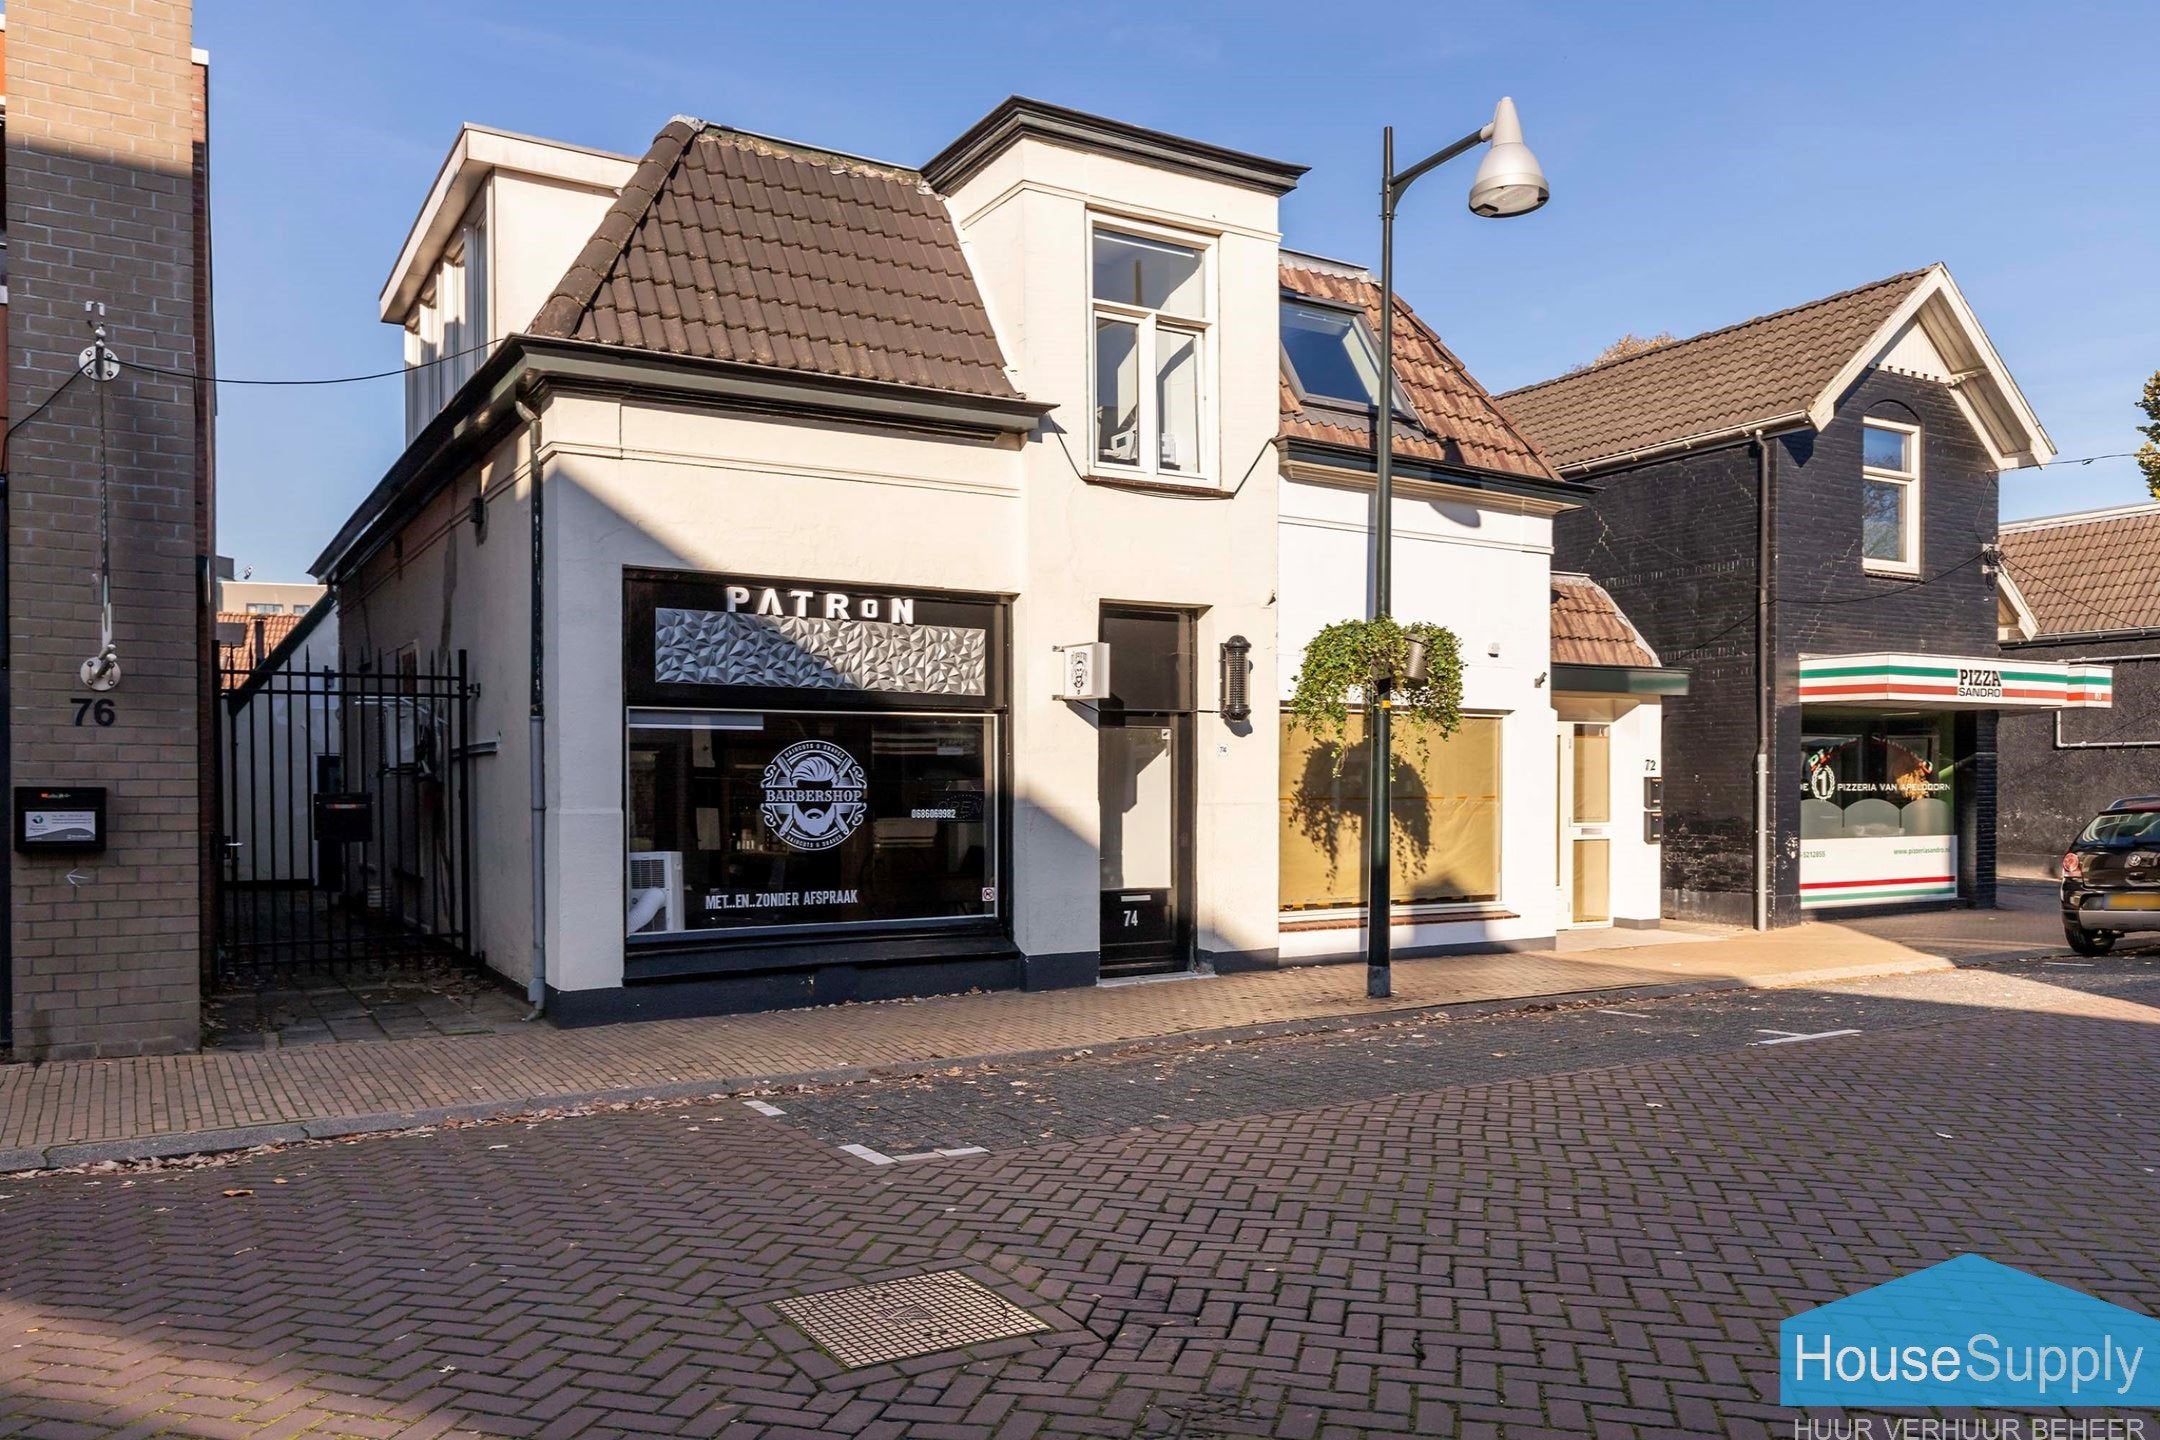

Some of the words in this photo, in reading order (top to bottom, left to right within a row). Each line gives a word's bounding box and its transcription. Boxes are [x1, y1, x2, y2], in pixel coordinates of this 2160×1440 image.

[1959, 669, 2001, 687] PIZZA
[1958, 686, 2000, 697] SANDRO
[70, 698, 115, 727] 76
[1645, 759, 1656, 771] 72
[1837, 783, 1877, 791] PIZZERIA
[1879, 783, 1898, 791] VAN
[765, 789, 863, 802] BARBERSHOP
[803, 889, 858, 905] AFSPRAAK
[1123, 910, 1139, 926] 74
